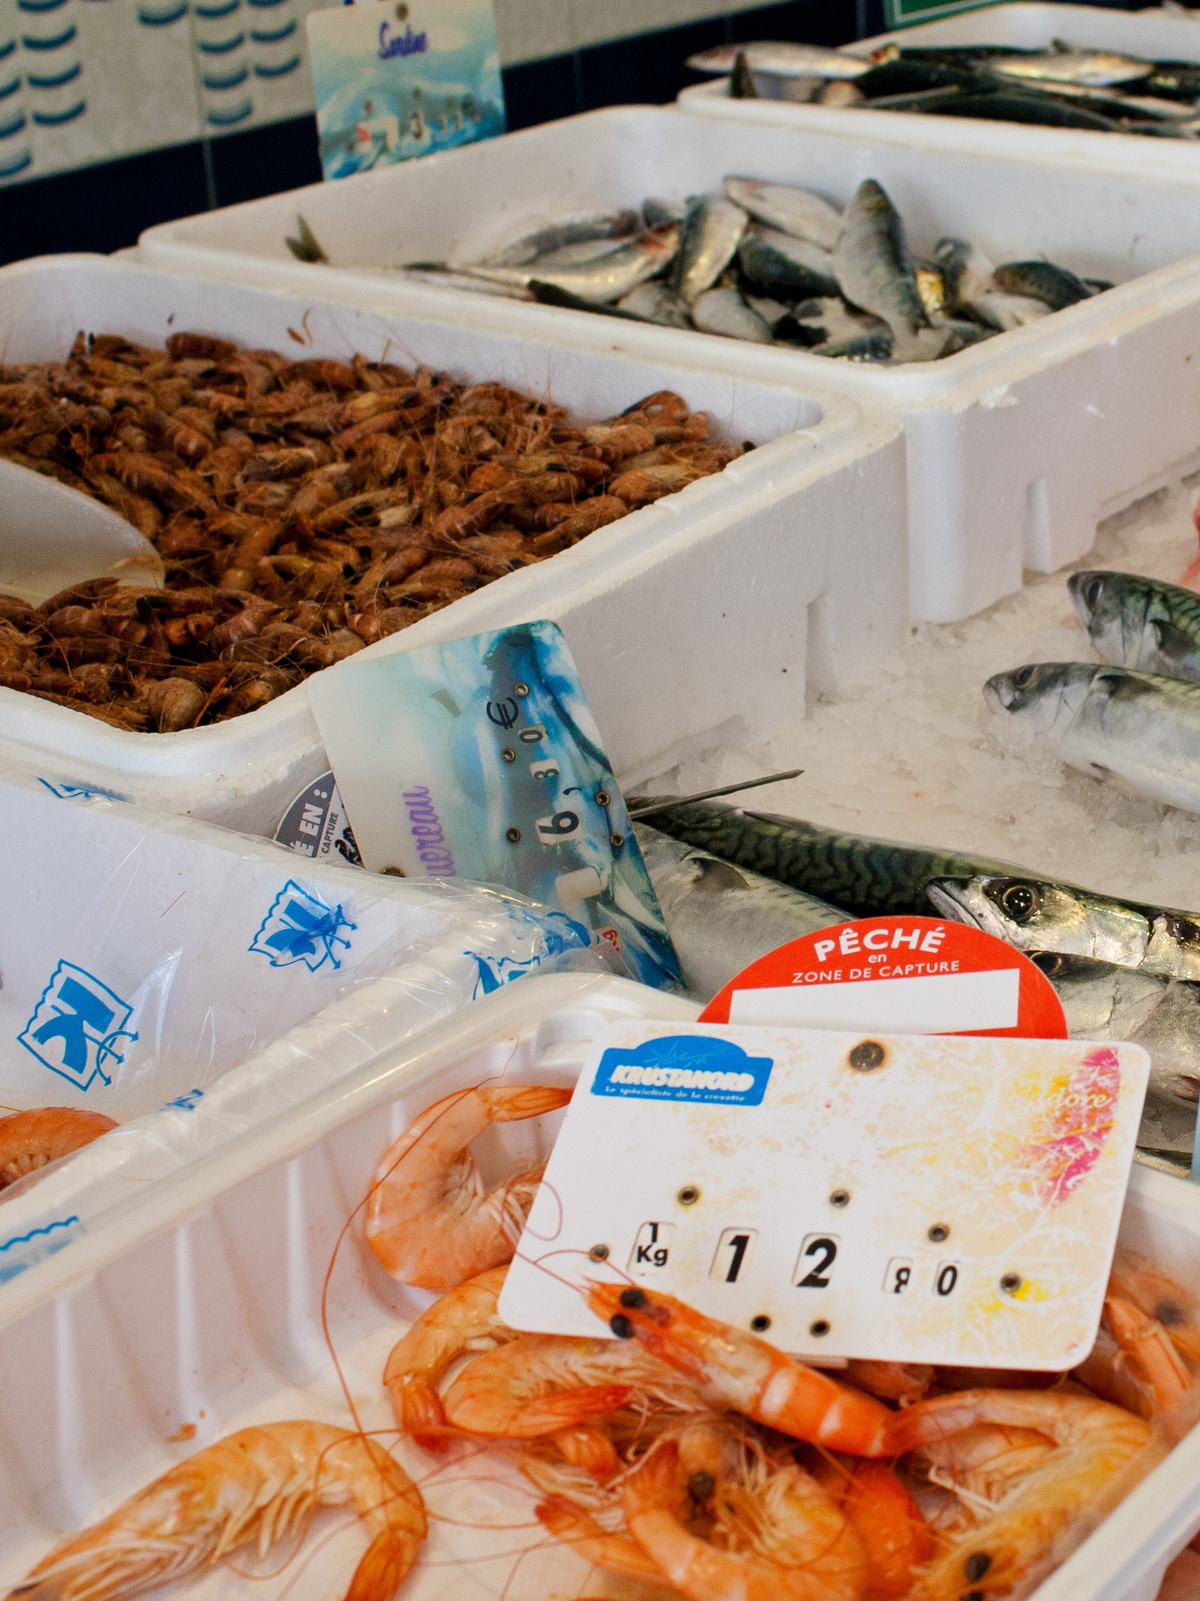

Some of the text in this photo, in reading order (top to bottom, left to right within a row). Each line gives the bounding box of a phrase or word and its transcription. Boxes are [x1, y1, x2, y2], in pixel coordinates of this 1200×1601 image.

[299, 803, 324, 836] EN
[321, 812, 339, 854] CAPTURE
[402, 785, 457, 877] uereau
[814, 926, 946, 962] PÊCHÉ
[868, 954, 887, 963] en
[792, 960, 960, 983] ZONE DE CAPTURE
[609, 1064, 755, 1093] KRUSTANORD
[636, 1245, 669, 1268] Kg
